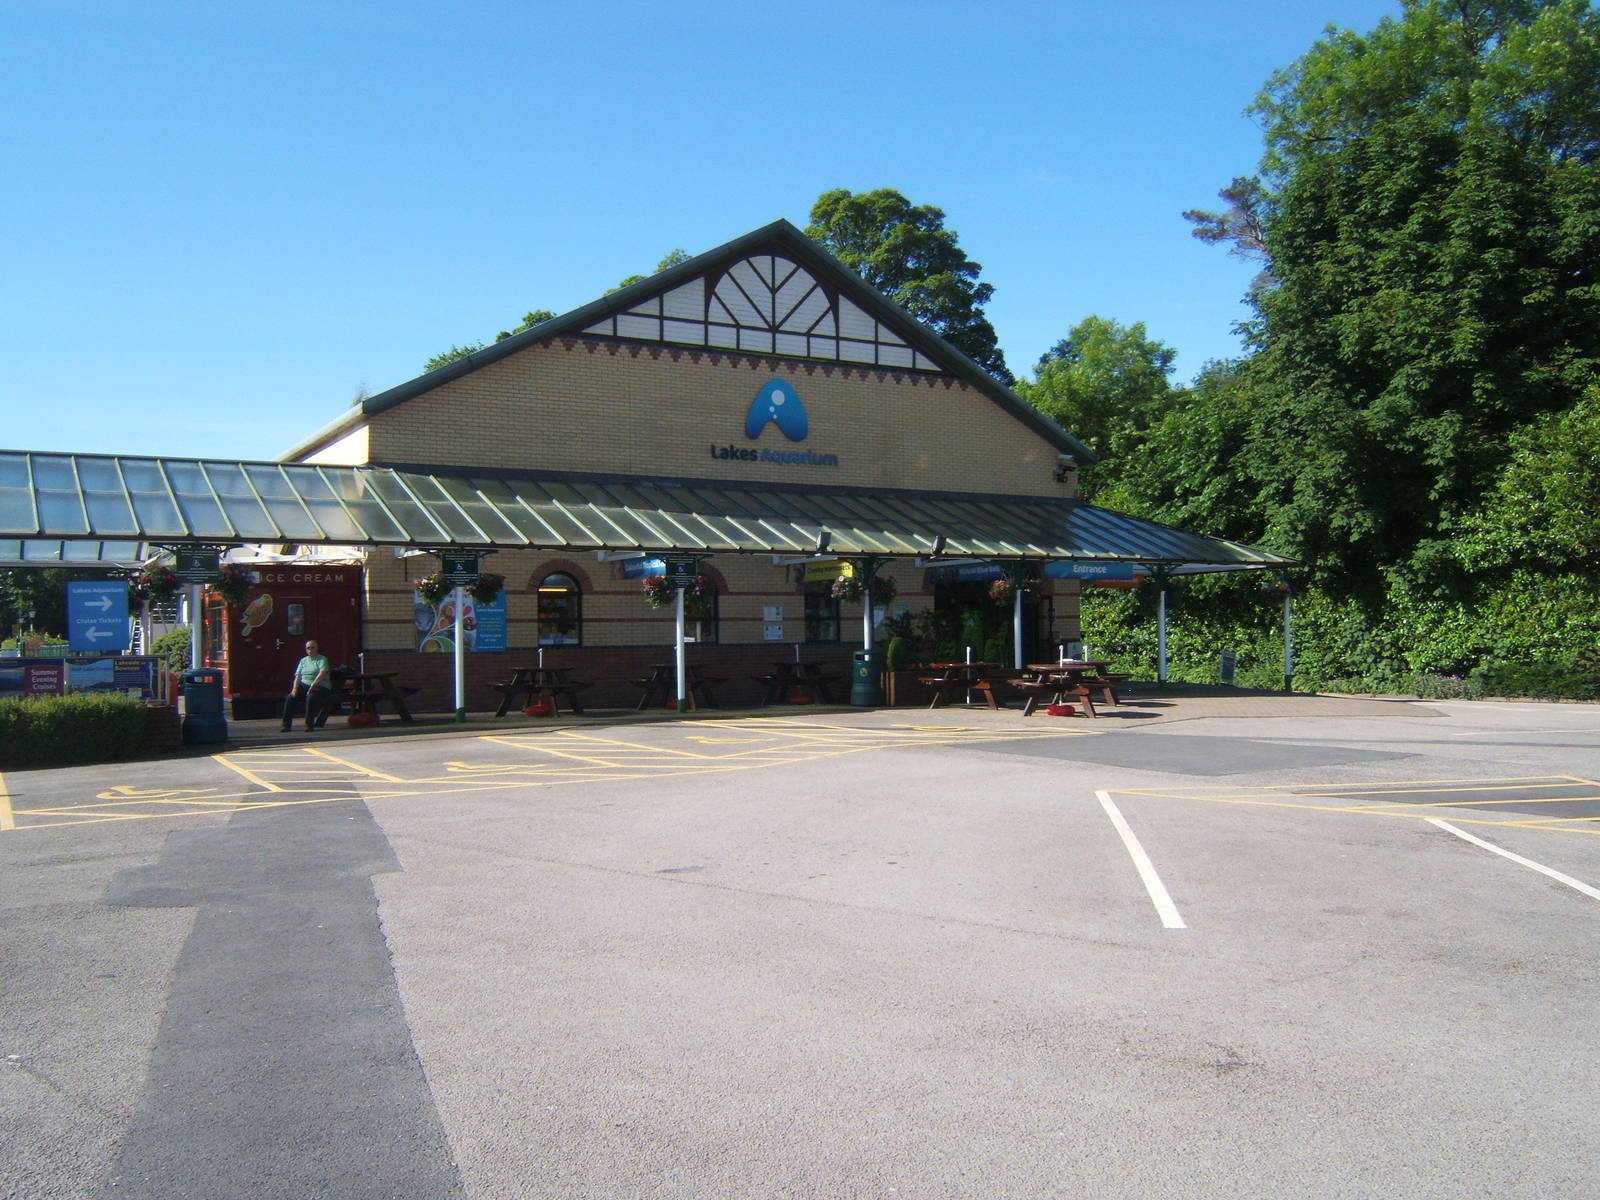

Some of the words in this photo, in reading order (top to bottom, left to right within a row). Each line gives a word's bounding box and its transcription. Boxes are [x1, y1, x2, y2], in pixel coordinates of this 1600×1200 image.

[710, 444, 758, 462] Lakes
[760, 447, 838, 466] Aquarium
[1073, 564, 1107, 573] Entrance
[292, 573, 344, 583] CREAM
